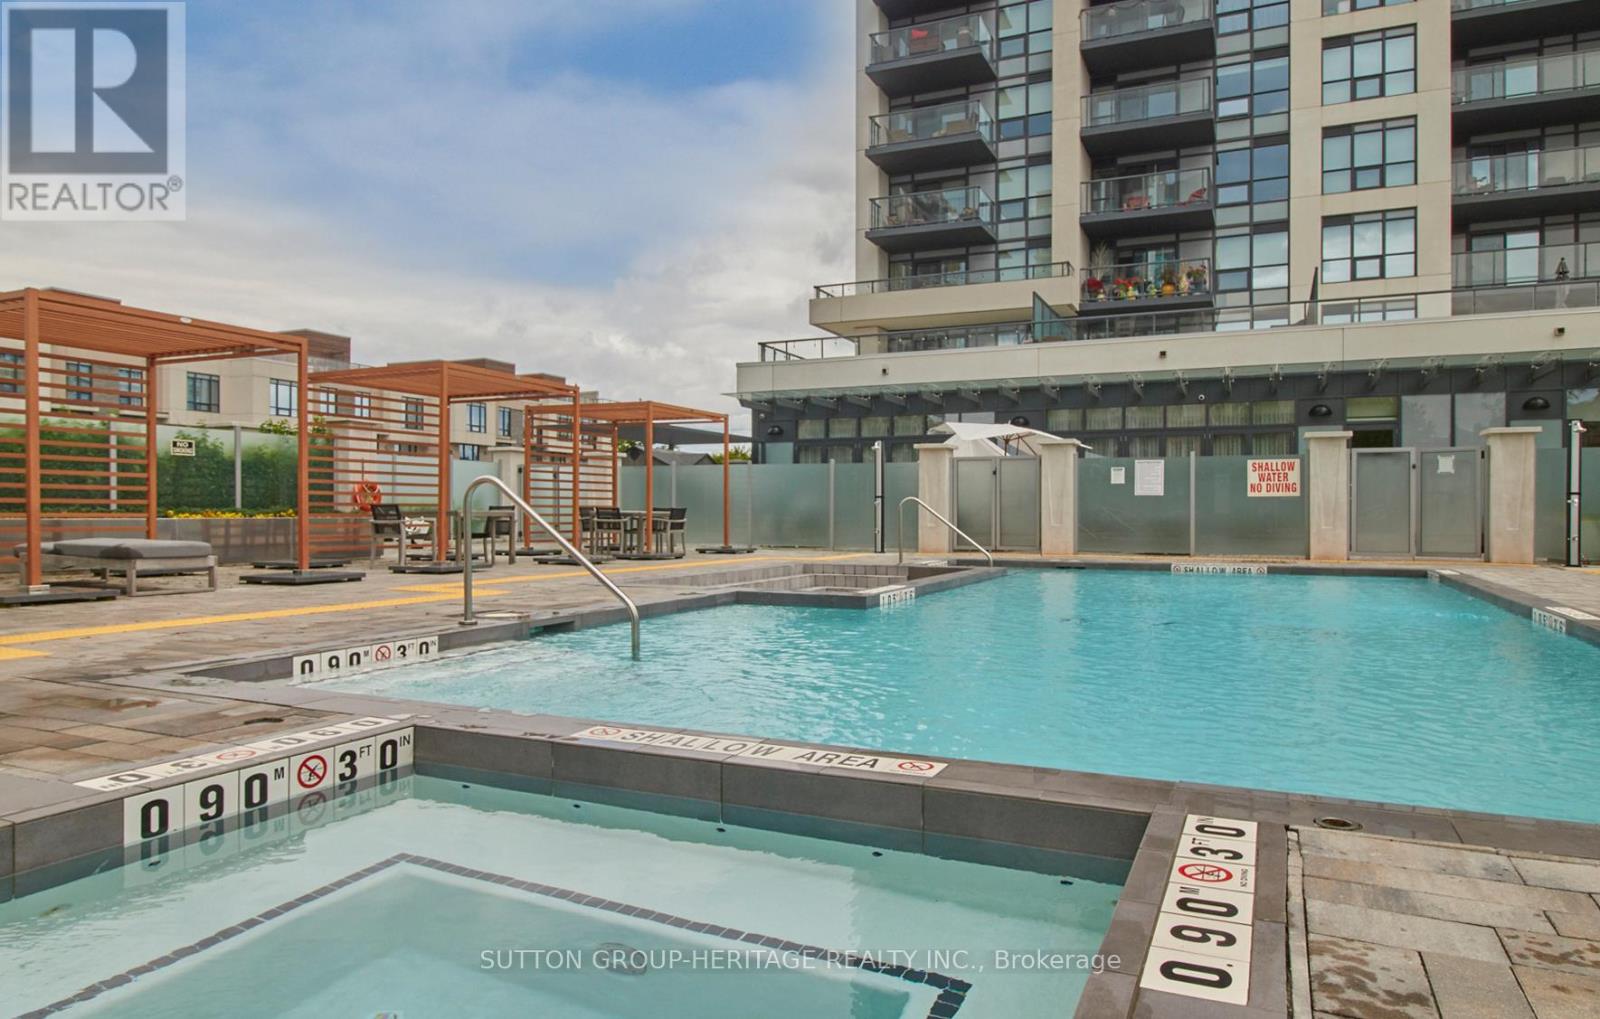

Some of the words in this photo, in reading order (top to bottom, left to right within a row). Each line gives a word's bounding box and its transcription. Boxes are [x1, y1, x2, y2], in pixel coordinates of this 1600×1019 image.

[1252, 461, 1295, 472] SHALLOW
[1258, 472, 1289, 482] WATER
[1250, 482, 1262, 493] NO
[1266, 482, 1297, 493] DIVING
[620, 731, 784, 757] SHALLOW
[791, 750, 881, 770] AREA
[274, 766, 285, 781] M
[338, 749, 358, 782] 3
[359, 744, 372, 758] FT
[380, 739, 398, 770] 0
[400, 734, 411, 748] IN
[1190, 846, 1244, 860] 3
